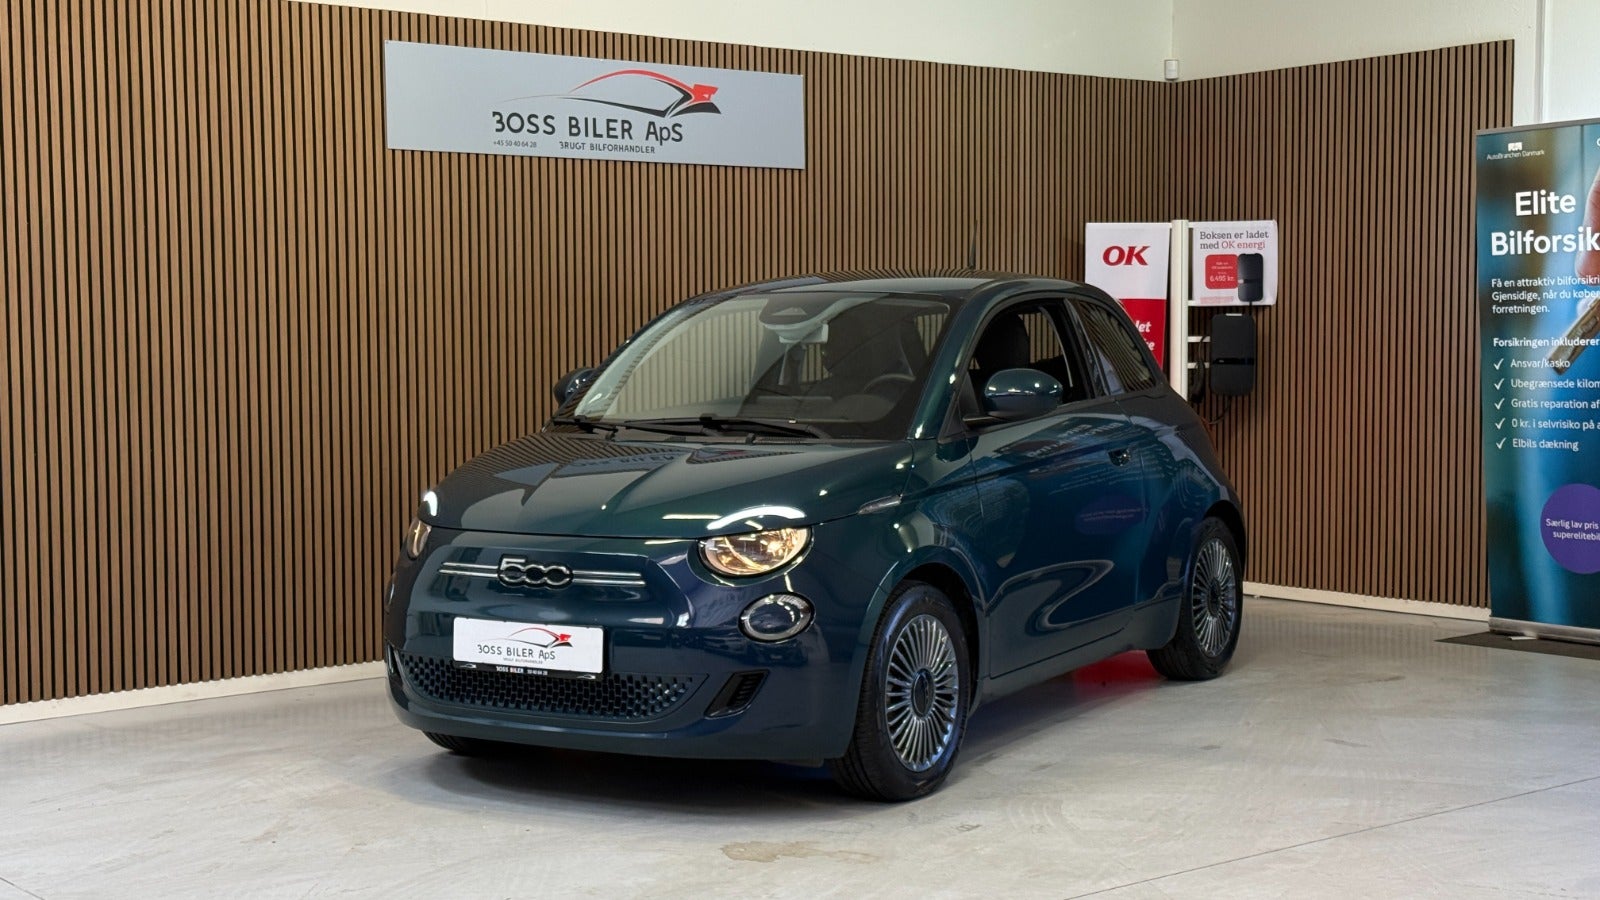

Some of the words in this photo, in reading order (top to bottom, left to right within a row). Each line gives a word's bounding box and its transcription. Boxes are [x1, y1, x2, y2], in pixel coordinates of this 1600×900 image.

[492, 111, 556, 135] BOSS
[568, 116, 633, 140] BILER
[645, 121, 684, 145] ApS
[560, 141, 586, 151] BRUGT
[590, 143, 656, 154] BILFORHANDLER
[1522, 150, 1544, 158] Danmark
[1516, 190, 1576, 216] Elite
[1200, 232, 1232, 240] Boksen
[1246, 230, 1269, 238] ladet
[1491, 226, 1600, 256] Bilforsik
[1222, 240, 1236, 249] OK
[1237, 240, 1266, 250] energi
[1102, 245, 1151, 266] OK
[1491, 277, 1502, 288] Få
[1517, 276, 1555, 287] attraktiv
[1492, 291, 1540, 302] Gjensidige,
[1543, 289, 1557, 300] når
[1560, 289, 1571, 299] du
[1492, 305, 1550, 315] forretningen.
[1493, 337, 1549, 348] Forsikringen
[1510, 358, 1570, 368] Ansvar/kasko
[1511, 379, 1574, 390] Ubegrænsede
[1511, 398, 1538, 408] Gratis
[1541, 399, 1588, 410] reparation
[1591, 399, 1600, 408] af
[1512, 418, 1518, 428] 0
[1520, 419, 1531, 428] kr.
[1538, 419, 1580, 429] selvrisiko
[1582, 419, 1594, 431] på
[1512, 438, 1537, 448] Elbils
[1539, 439, 1579, 451] dækning
[1546, 518, 1570, 529] Særlig
[1571, 520, 1582, 528] lav
[1584, 520, 1599, 530] pris
[499, 556, 572, 587] 500
[478, 644, 502, 656] BOSS
[506, 647, 534, 658] BILER
[539, 650, 556, 662] ApS
